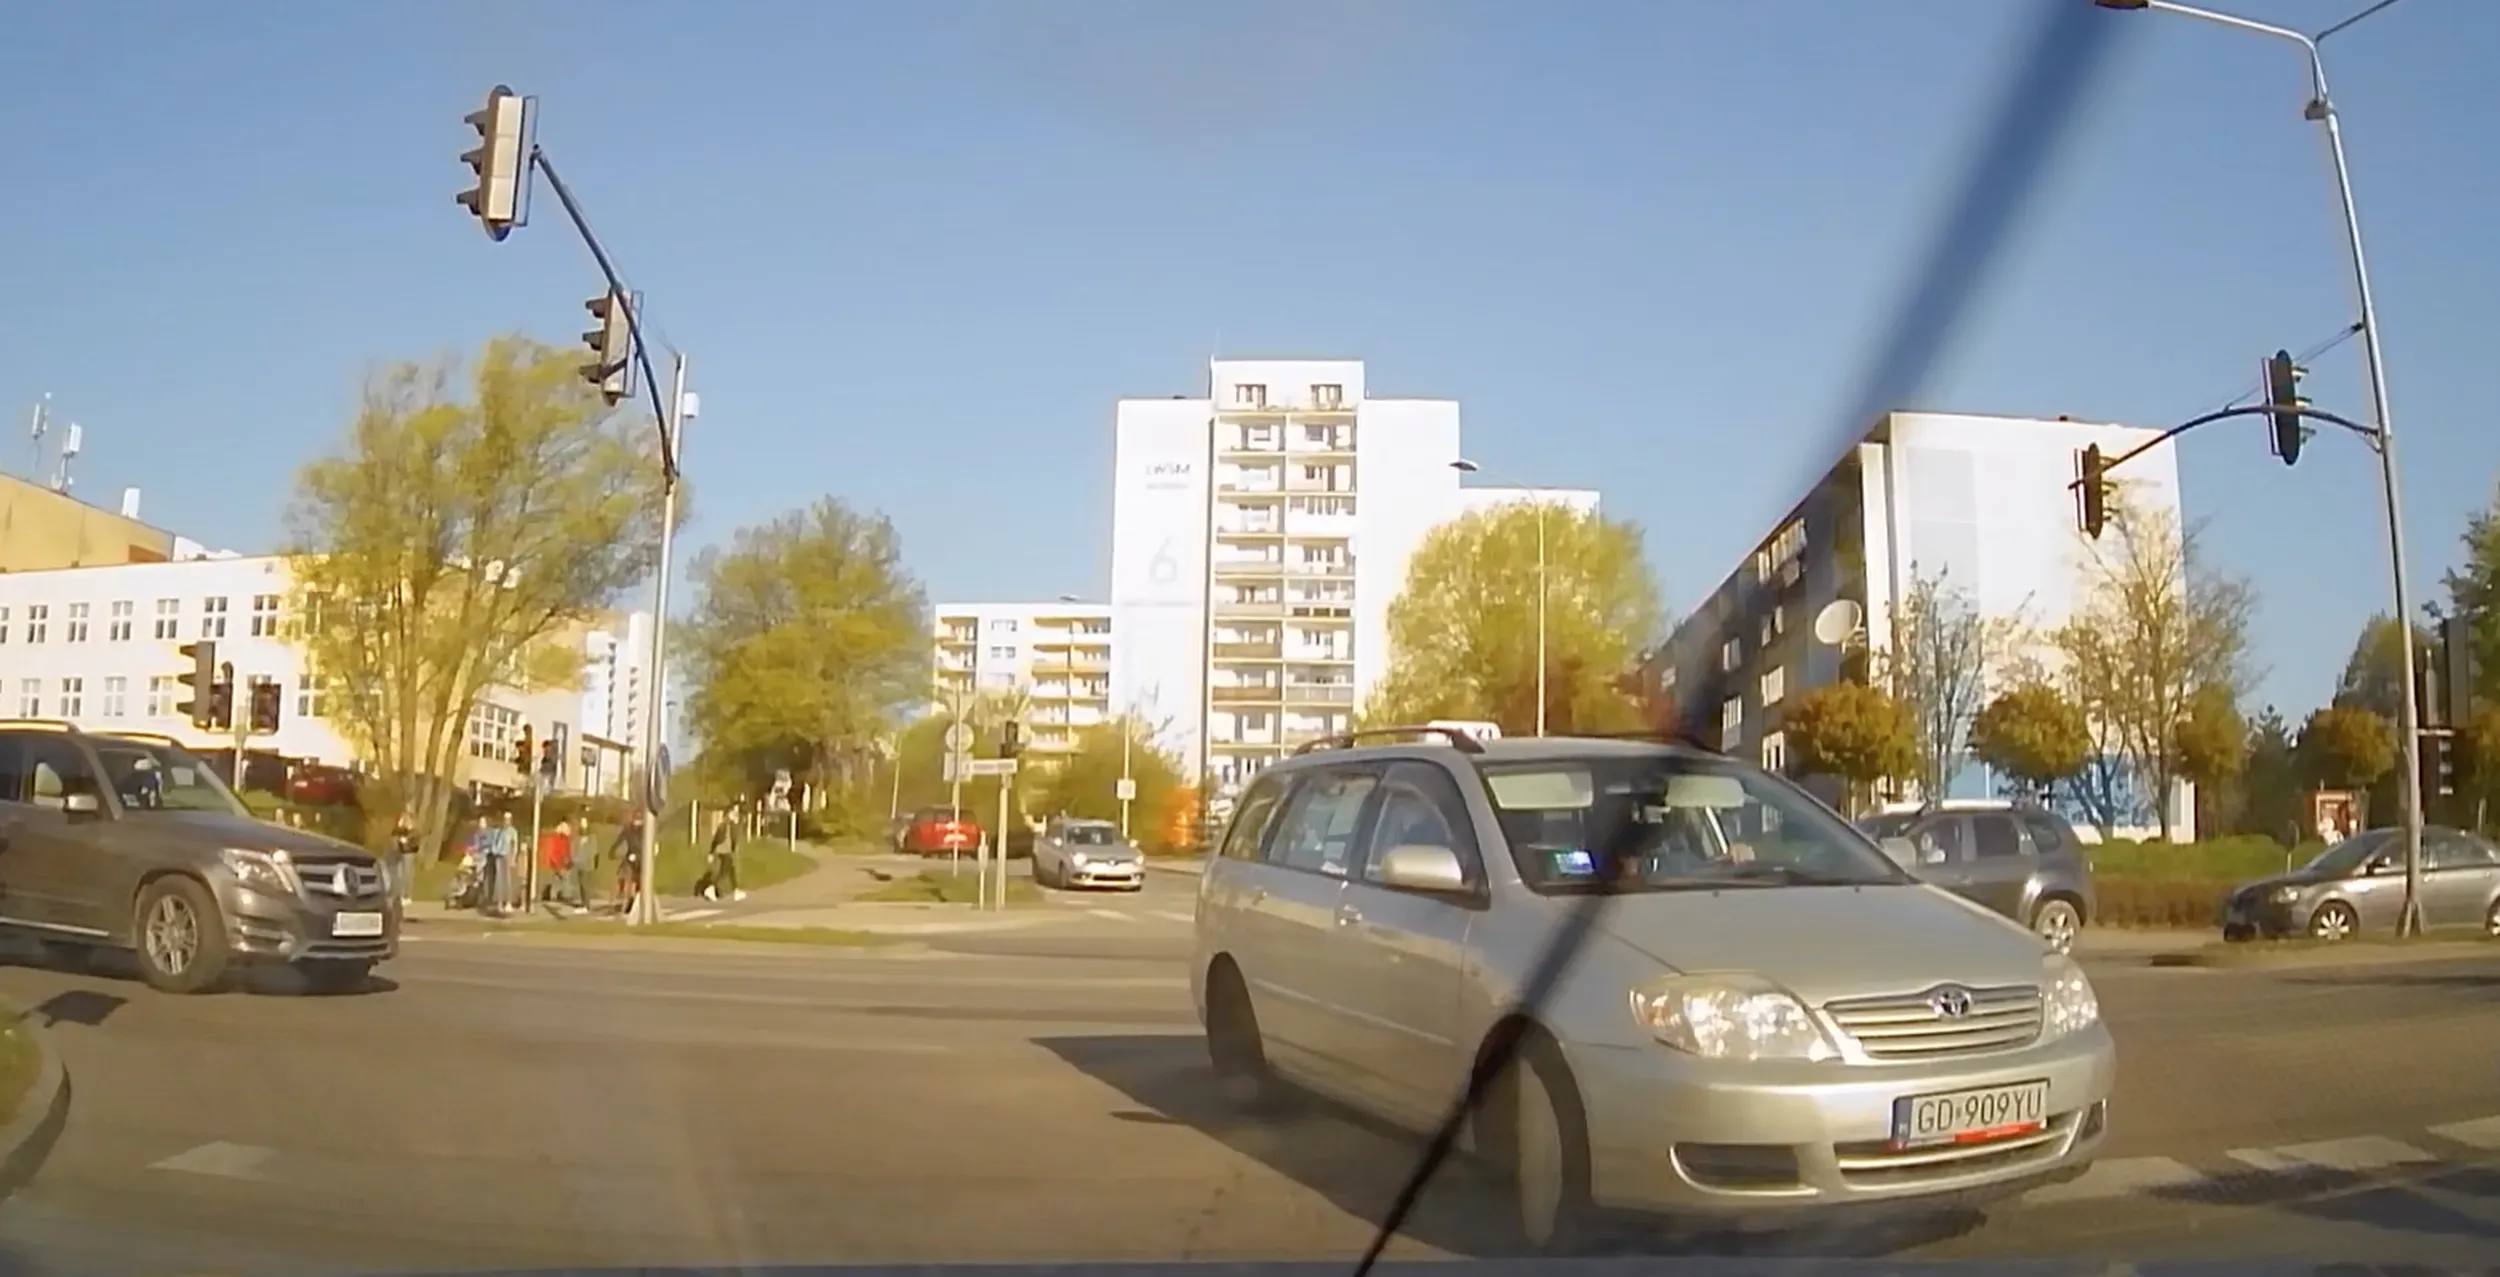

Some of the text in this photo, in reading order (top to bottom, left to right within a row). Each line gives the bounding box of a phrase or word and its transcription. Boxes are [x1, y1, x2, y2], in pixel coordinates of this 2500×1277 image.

[1148, 535, 1178, 585] 6
[1918, 1088, 2042, 1133] GD 909YU
